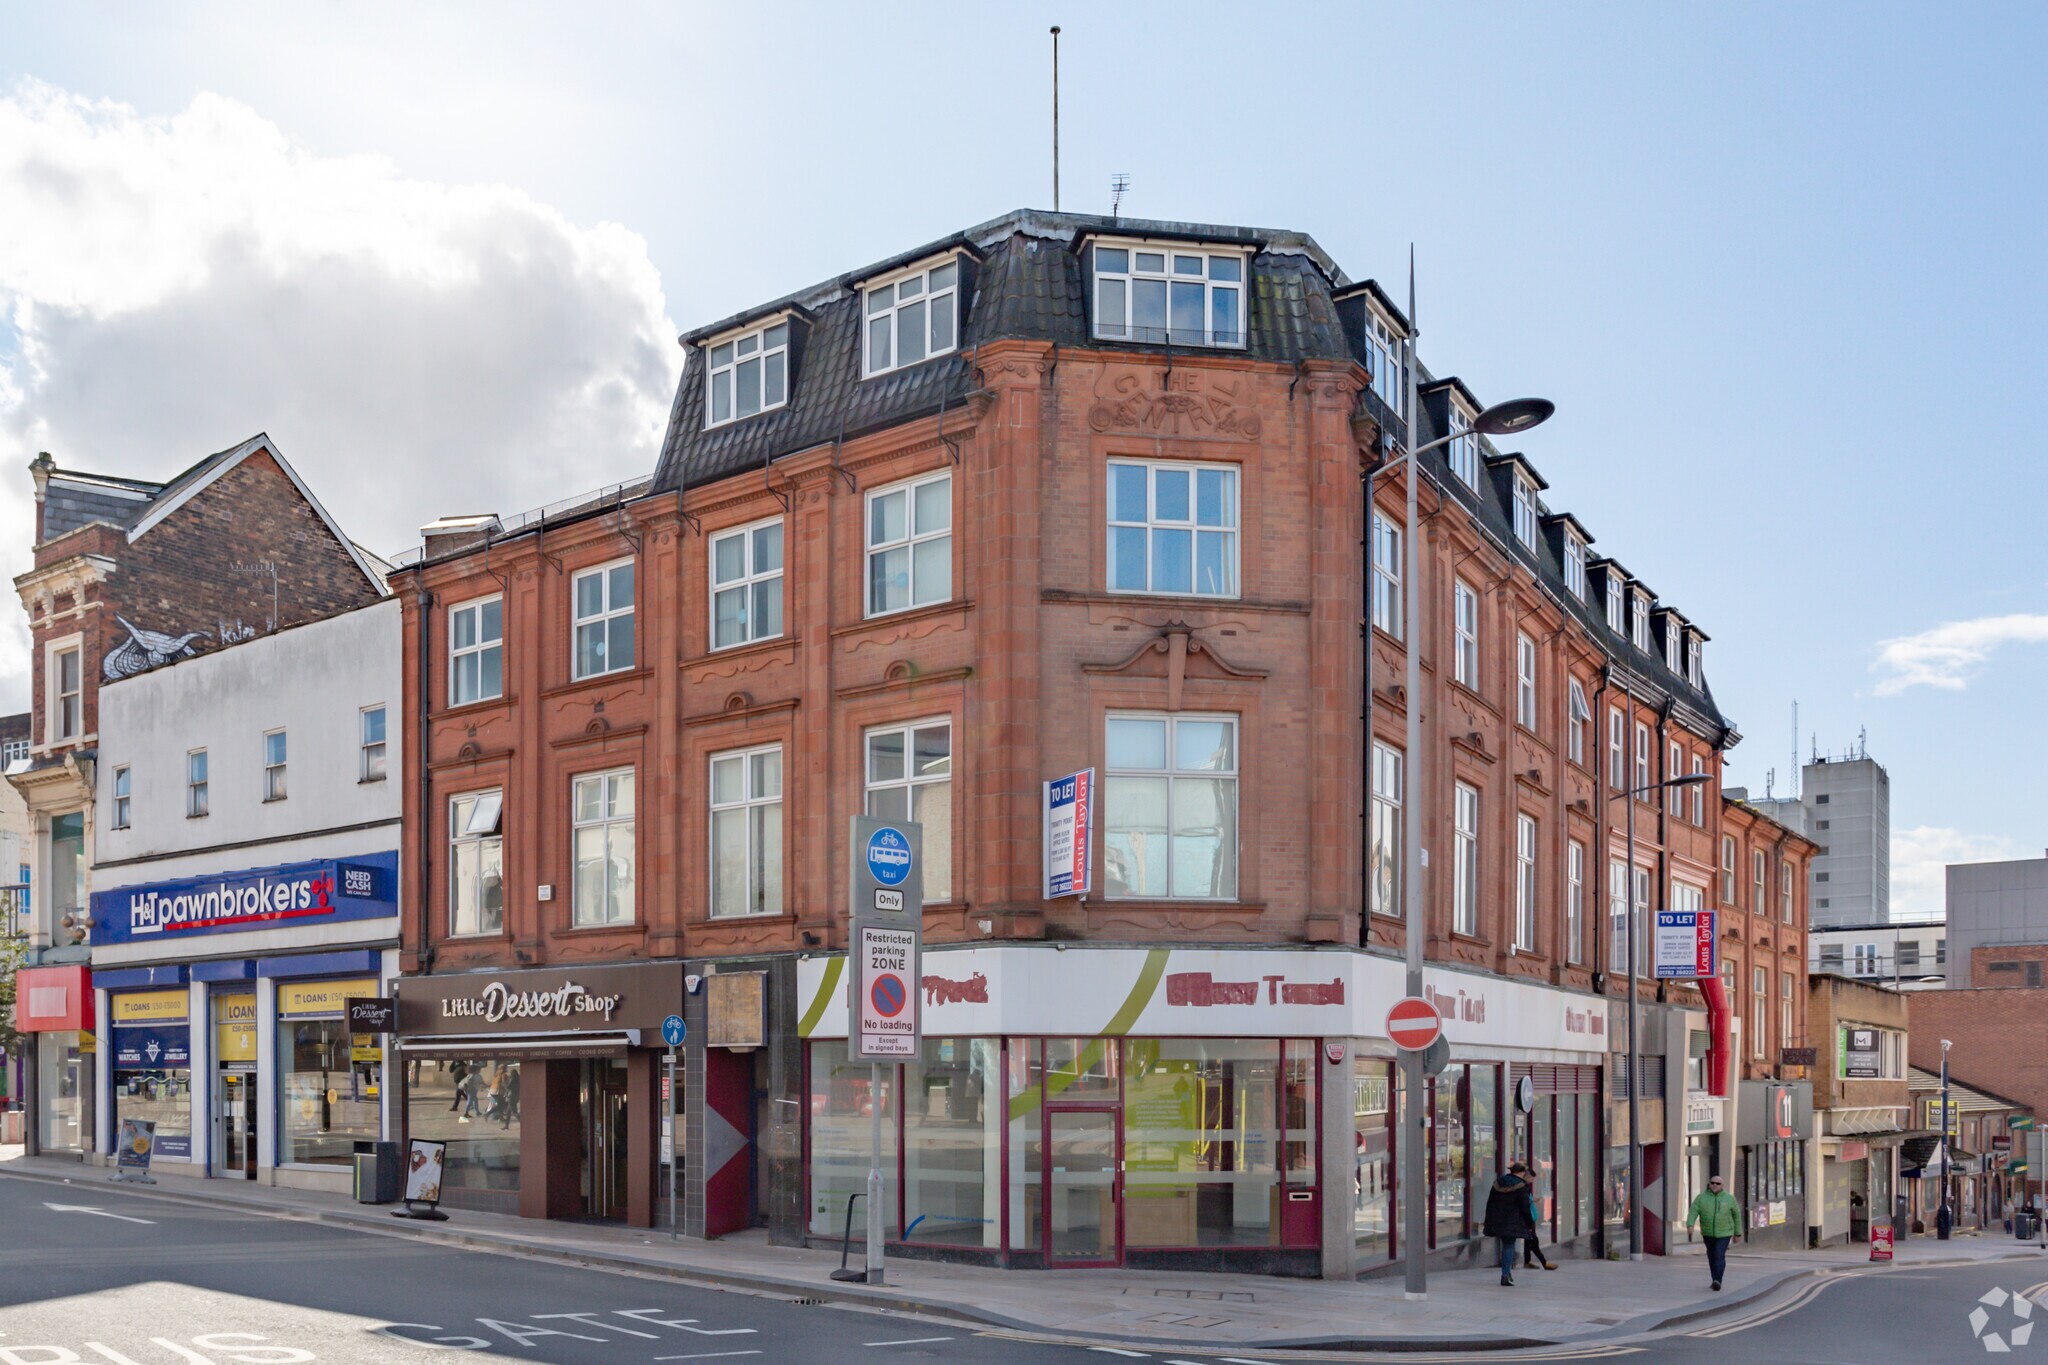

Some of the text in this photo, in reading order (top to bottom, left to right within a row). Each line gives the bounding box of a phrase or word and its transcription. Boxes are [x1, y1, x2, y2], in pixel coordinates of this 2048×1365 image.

[1154, 370, 1199, 393] THE
[1114, 373, 1240, 434] CENTRAL
[1051, 782, 1075, 803] TO LET
[1074, 779, 1088, 884] Louis Taylor
[345, 870, 371, 882] NEED
[882, 869, 896, 879] taxi
[345, 880, 371, 891] CASH
[131, 878, 311, 926] H&T pawnbrokers
[879, 894, 900, 907] Only
[1660, 915, 1694, 924] TO LET
[866, 932, 912, 945] Restricted
[1698, 915, 1713, 973] Louis Taylor
[872, 945, 905, 957] parking
[872, 957, 905, 970] ZONE
[303, 993, 328, 1003] LOANS
[442, 981, 614, 1022] Little Dessert Shop
[130, 1002, 150, 1012] LOANS
[229, 1004, 256, 1019] LOAN
[352, 1006, 391, 1019] Dessert
[864, 1019, 913, 1031] No loading
[241, 1033, 249, 1049] &
[118, 1053, 187, 1061] WATCHES JEWELLERY
[1688, 1102, 1715, 1121] Trinity
[364, 1308, 759, 1349] GATE
